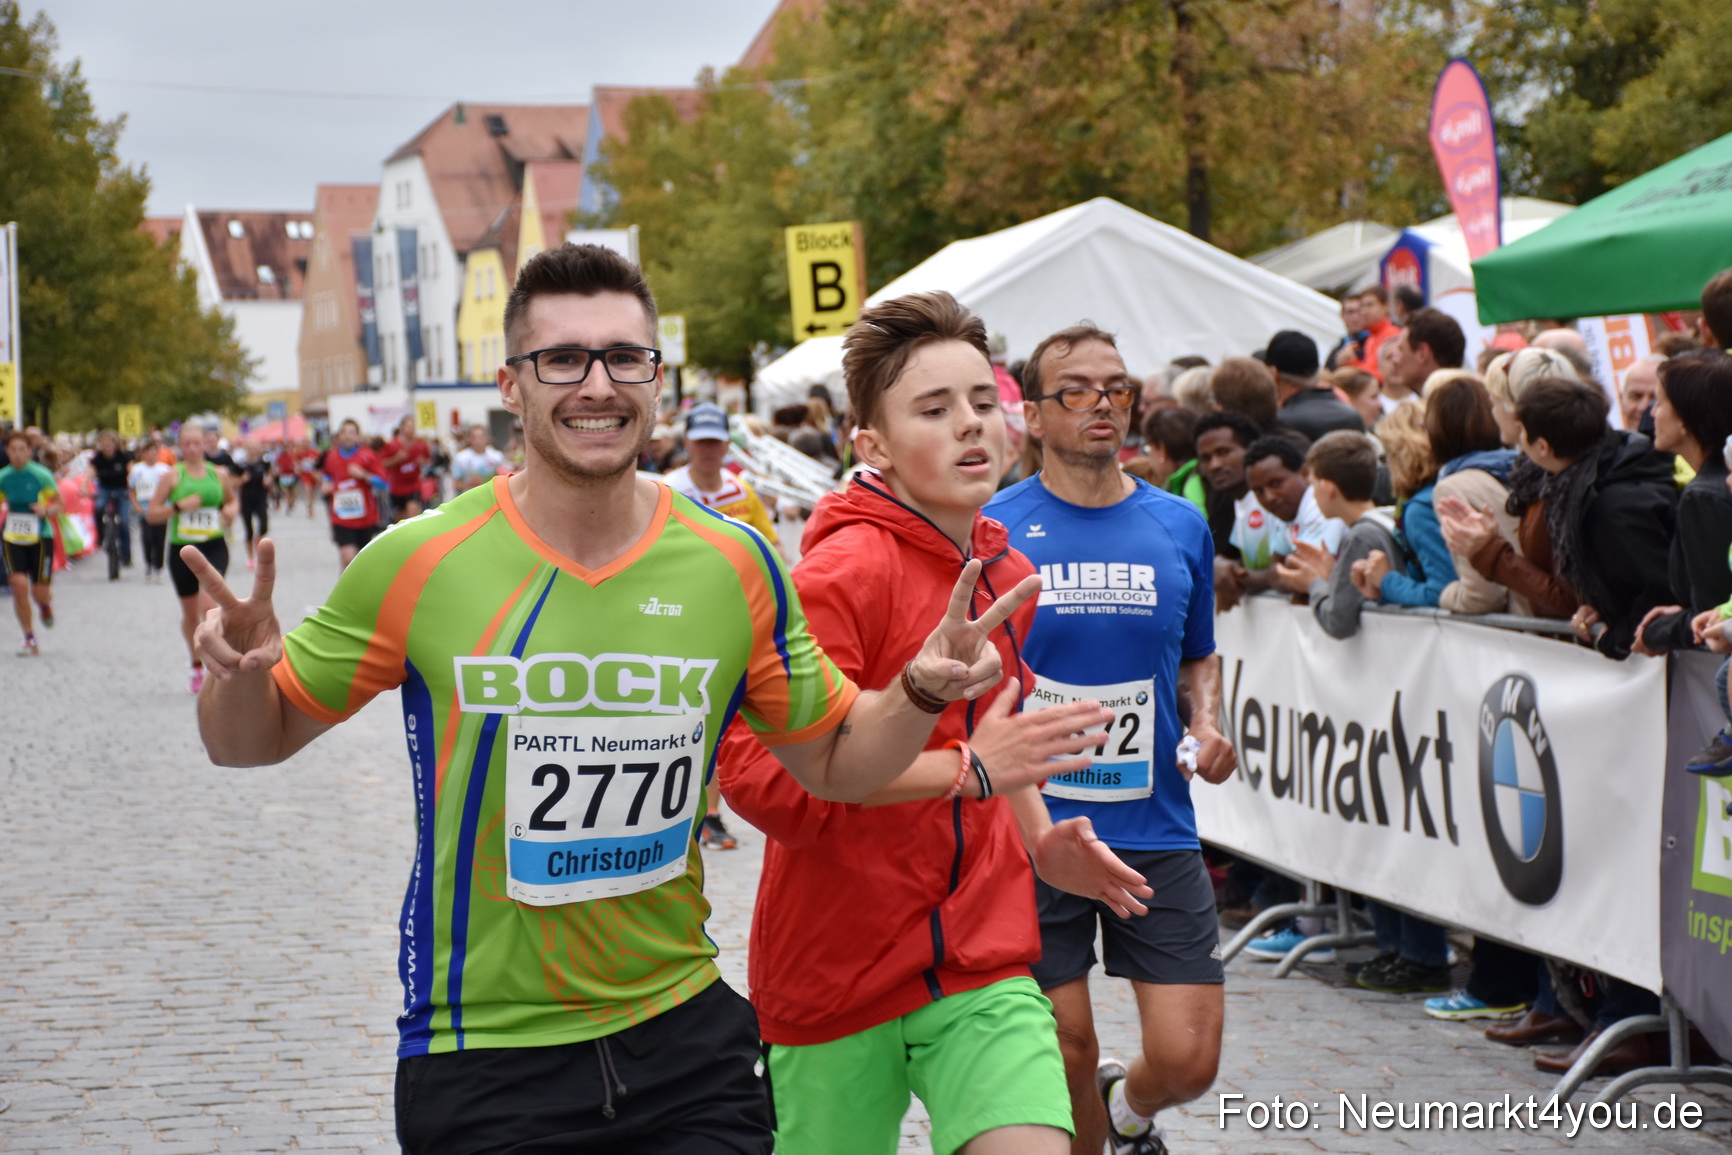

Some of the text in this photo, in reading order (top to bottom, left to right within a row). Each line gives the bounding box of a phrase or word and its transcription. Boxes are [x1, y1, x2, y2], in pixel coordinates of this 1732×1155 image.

[796, 232, 854, 251] Block
[811, 263, 846, 313] B
[1054, 591, 1152, 603] TECHNOLOGY
[1055, 606, 1153, 616] WASTE WATER Solutions
[455, 655, 715, 712] BOCK
[1480, 678, 1549, 757] BMW
[514, 734, 687, 752] PARTL Neumarkt
[1217, 655, 1460, 847] Neumarkt
[529, 756, 692, 831] 2770
[514, 825, 522, 837] C
[547, 840, 664, 878] Christoph
